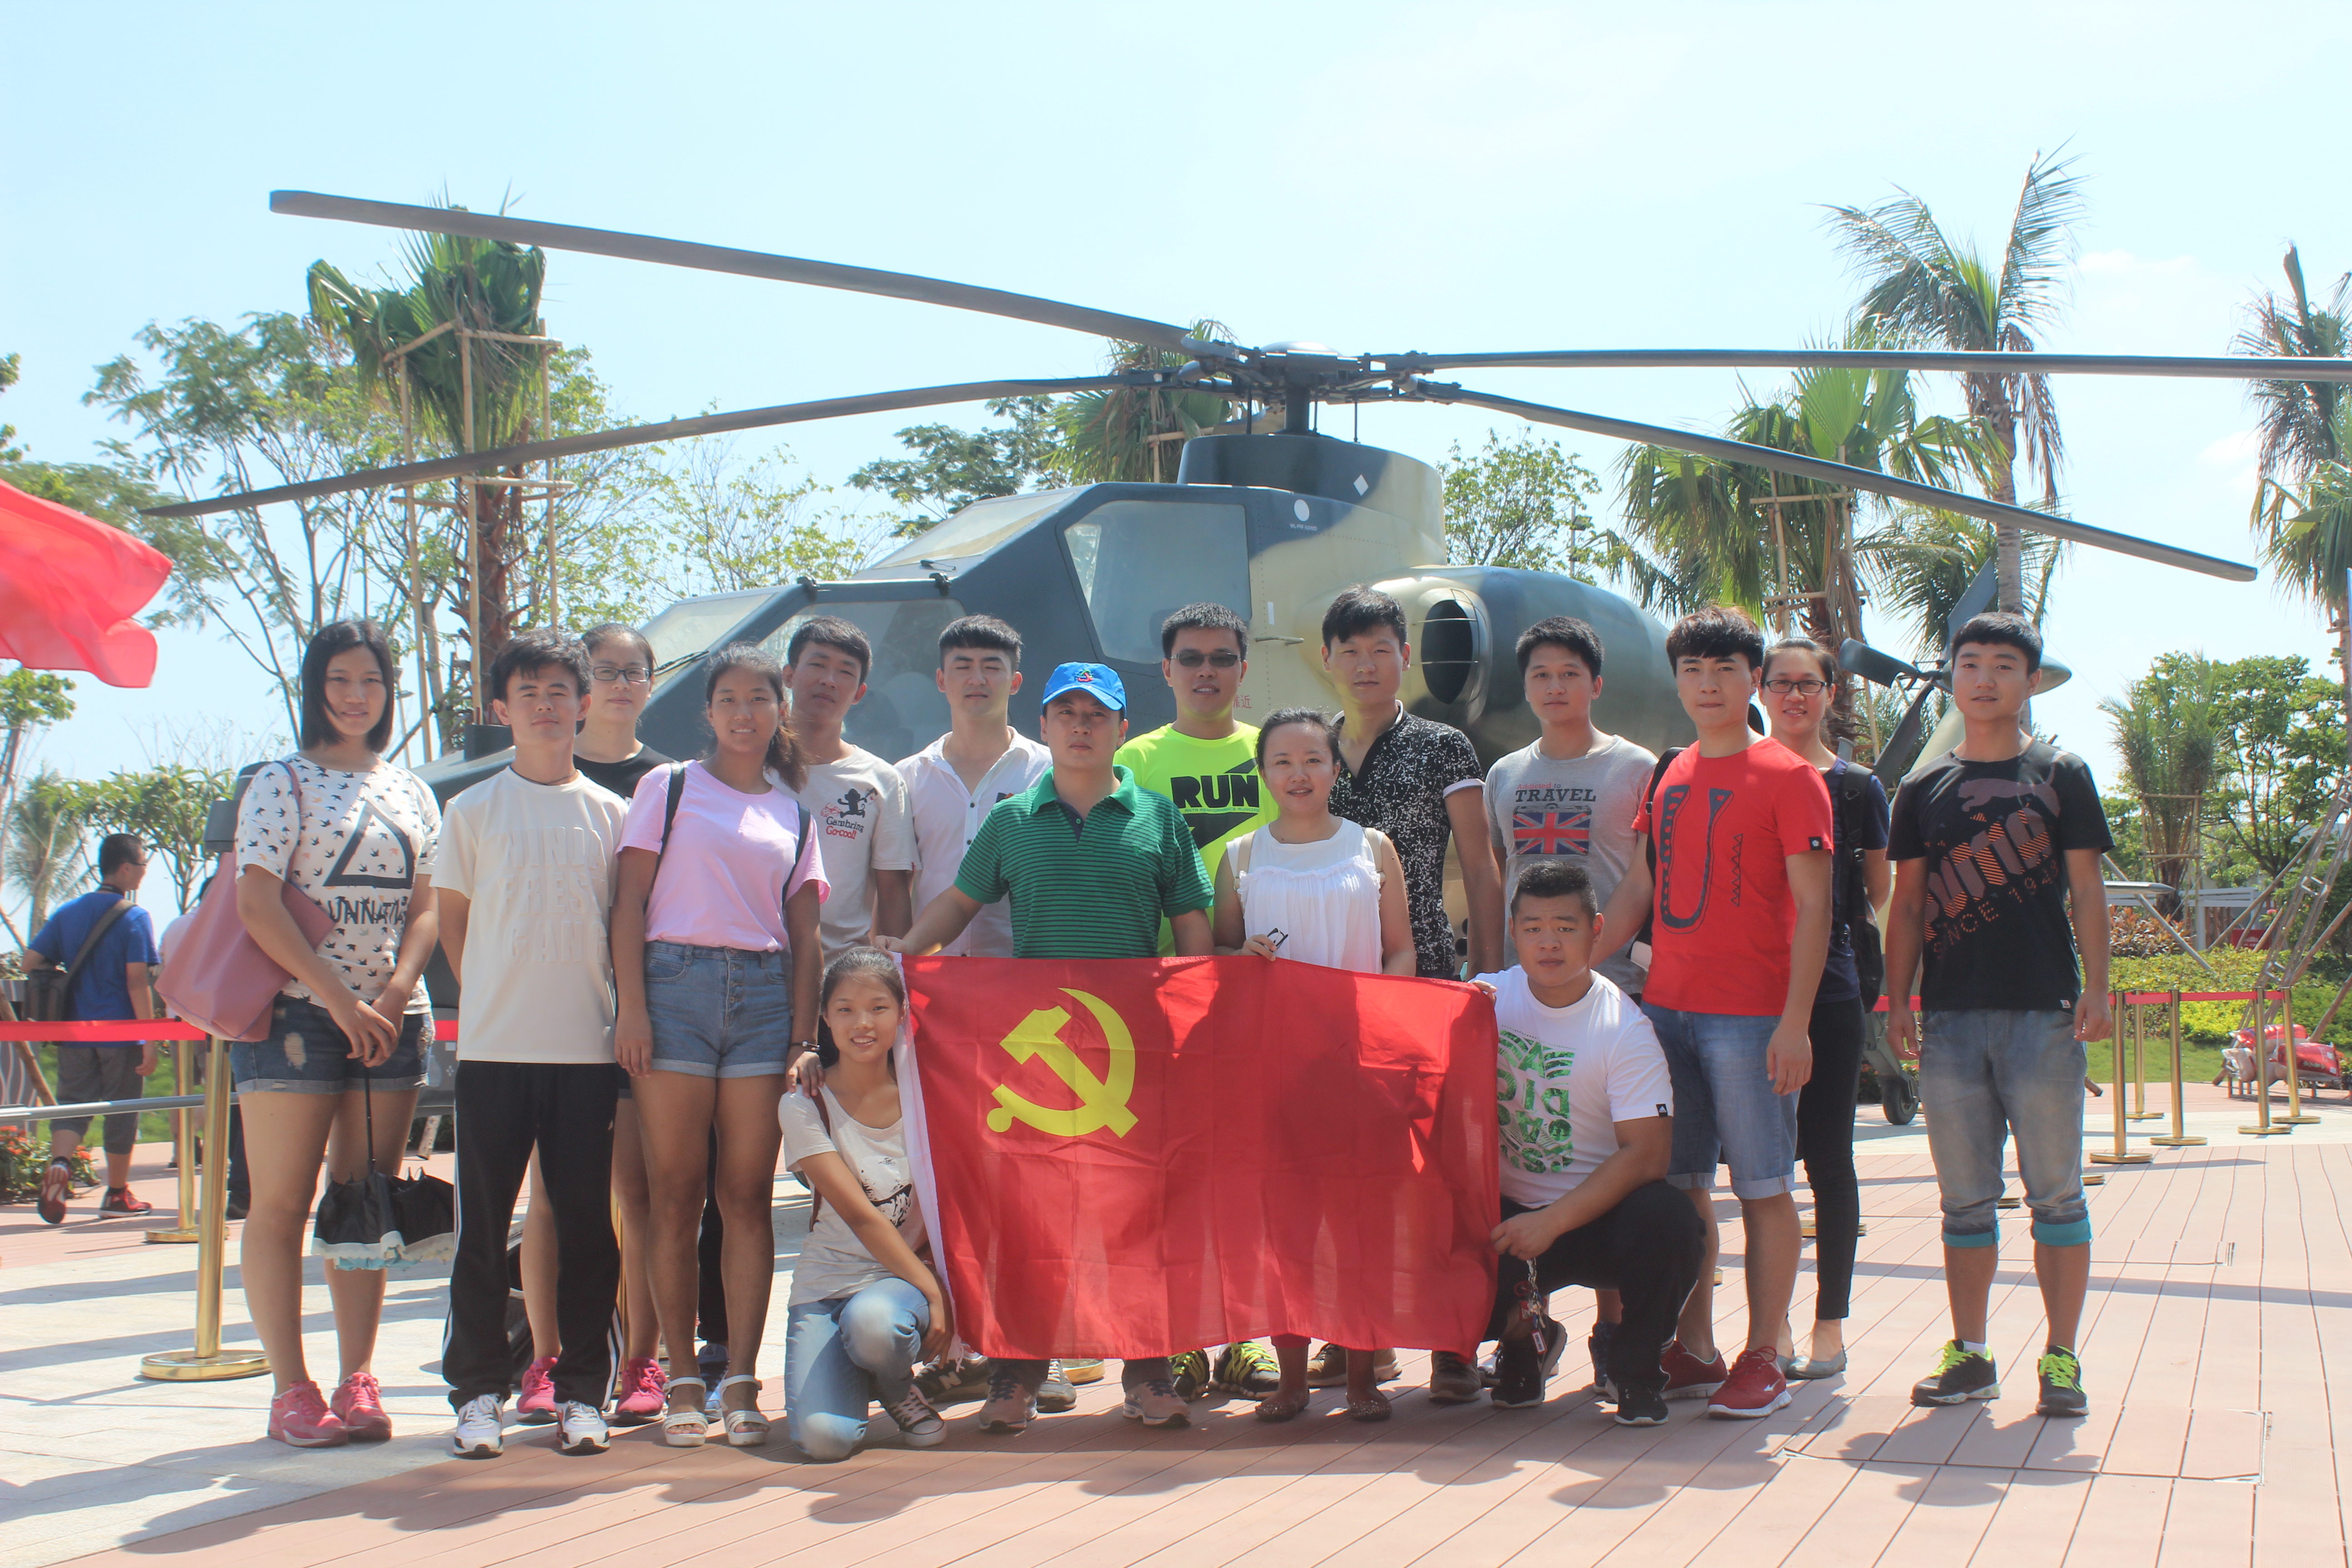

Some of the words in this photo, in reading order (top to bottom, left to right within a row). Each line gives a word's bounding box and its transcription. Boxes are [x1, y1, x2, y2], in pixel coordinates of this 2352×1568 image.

[1171, 774, 1259, 808] RUN
[1515, 788, 1597, 803] TRAVEL
[827, 817, 864, 833] Gambring
[503, 920, 608, 965] GANG
